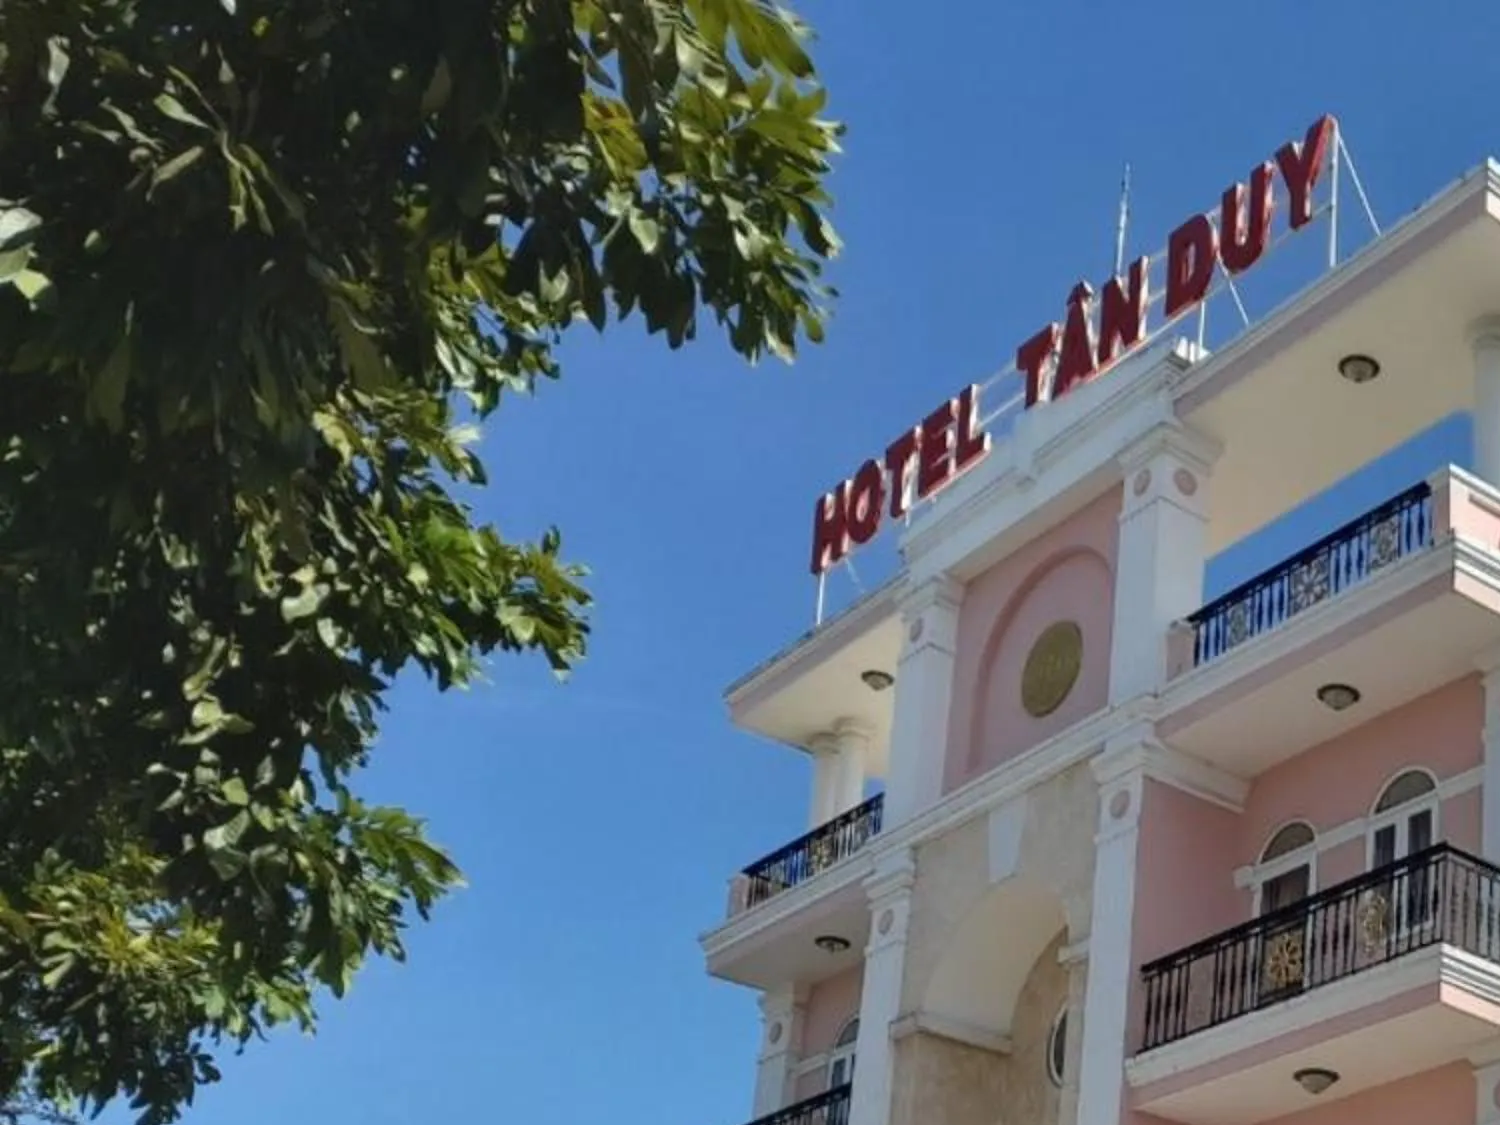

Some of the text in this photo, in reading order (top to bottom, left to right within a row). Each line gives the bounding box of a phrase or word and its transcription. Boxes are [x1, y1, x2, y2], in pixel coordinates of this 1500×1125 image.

[811, 112, 1338, 575] HOTEL TÂN DUY
